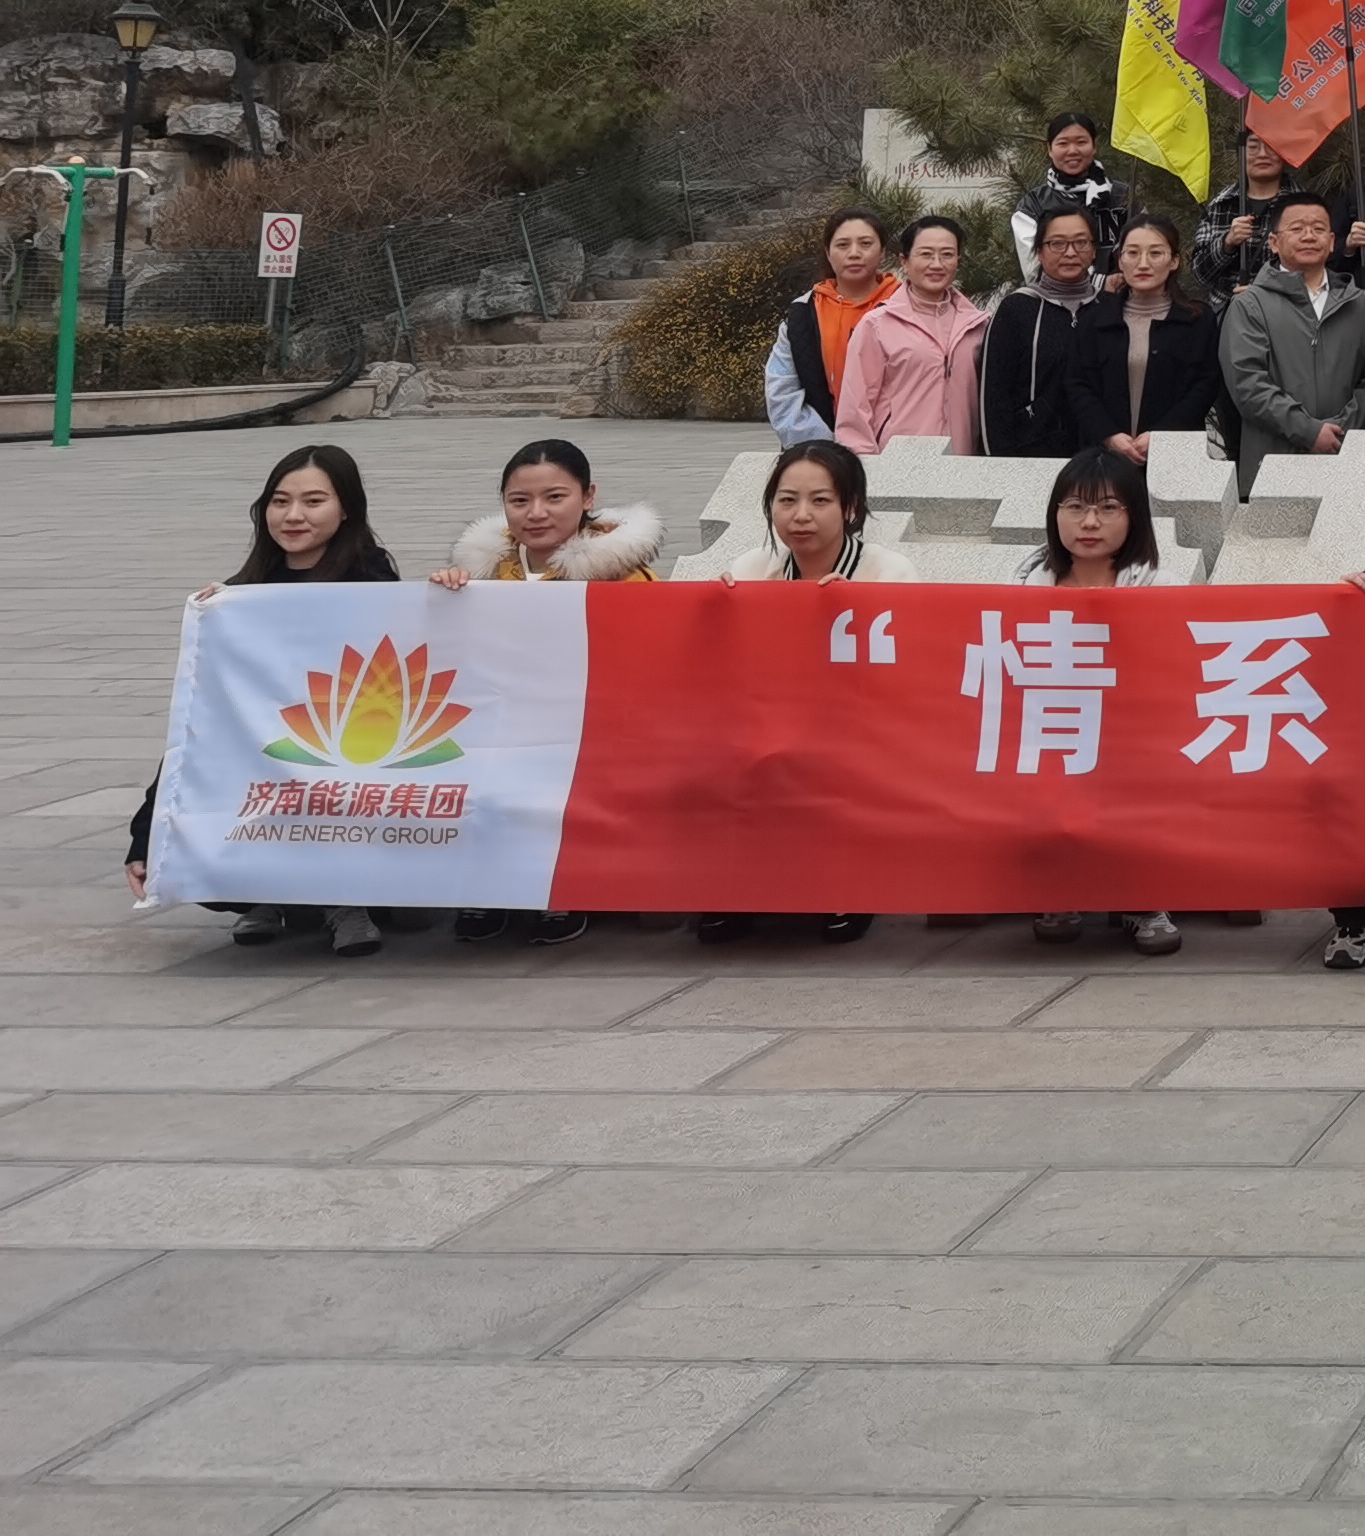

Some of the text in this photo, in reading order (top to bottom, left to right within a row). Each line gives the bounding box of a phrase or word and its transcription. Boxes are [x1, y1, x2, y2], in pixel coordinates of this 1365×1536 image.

[237, 779, 470, 819] 济南能源集团
[224, 824, 459, 845] JINAN ENERGY GROUP
